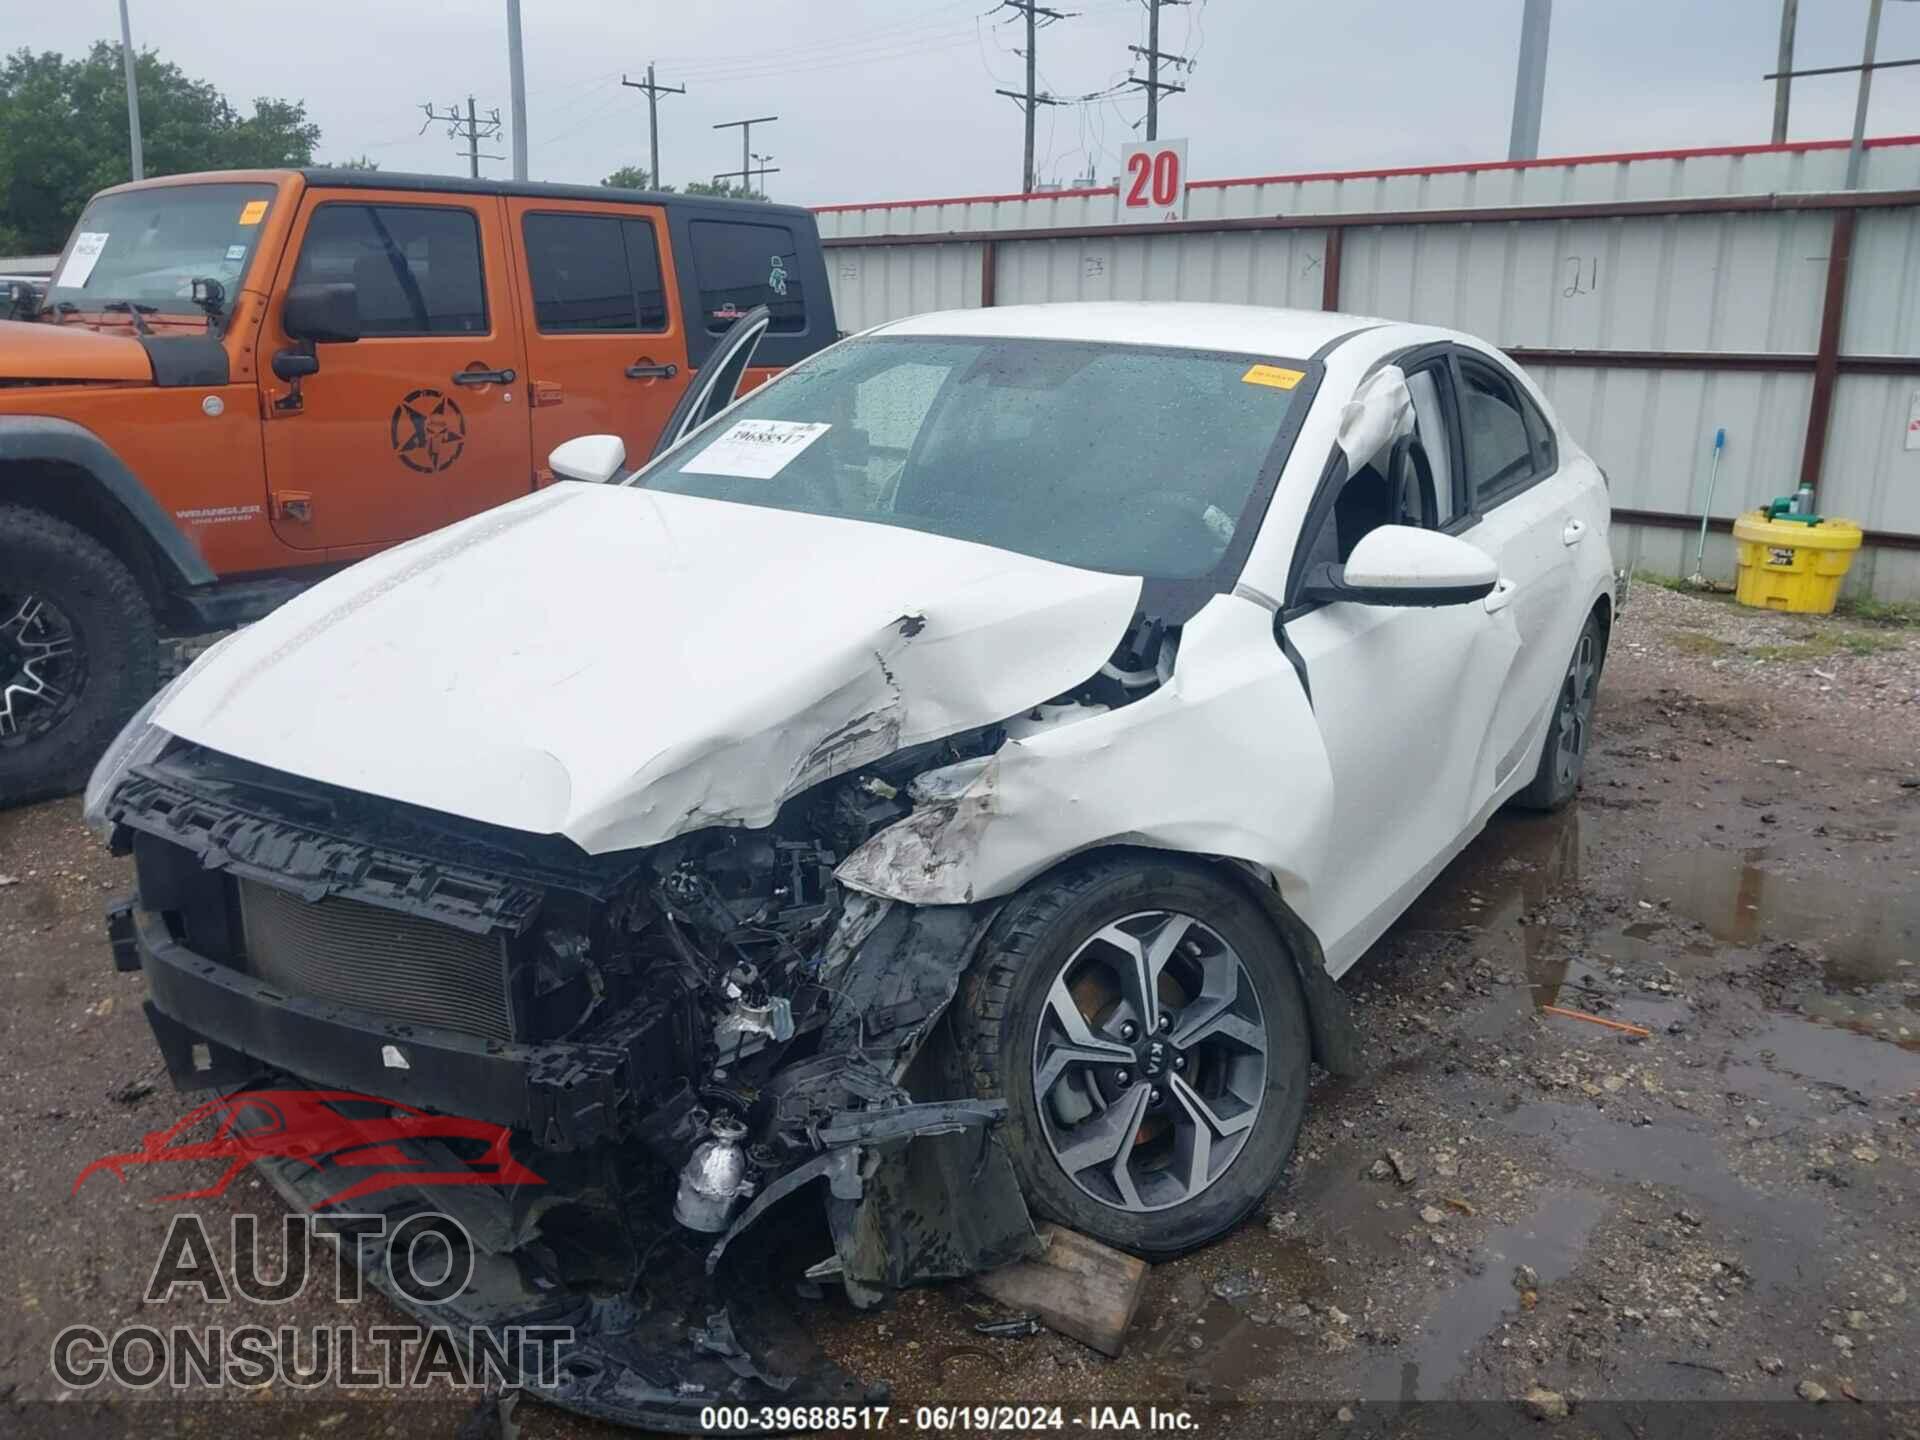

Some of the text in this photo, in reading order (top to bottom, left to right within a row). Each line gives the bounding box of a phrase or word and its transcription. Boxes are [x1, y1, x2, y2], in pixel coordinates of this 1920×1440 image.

[1126, 149, 1179, 208] 20
[1562, 256, 1597, 298] 21
[175, 505, 261, 519] WRANGLER
[1147, 1043, 1163, 1074] KIA
